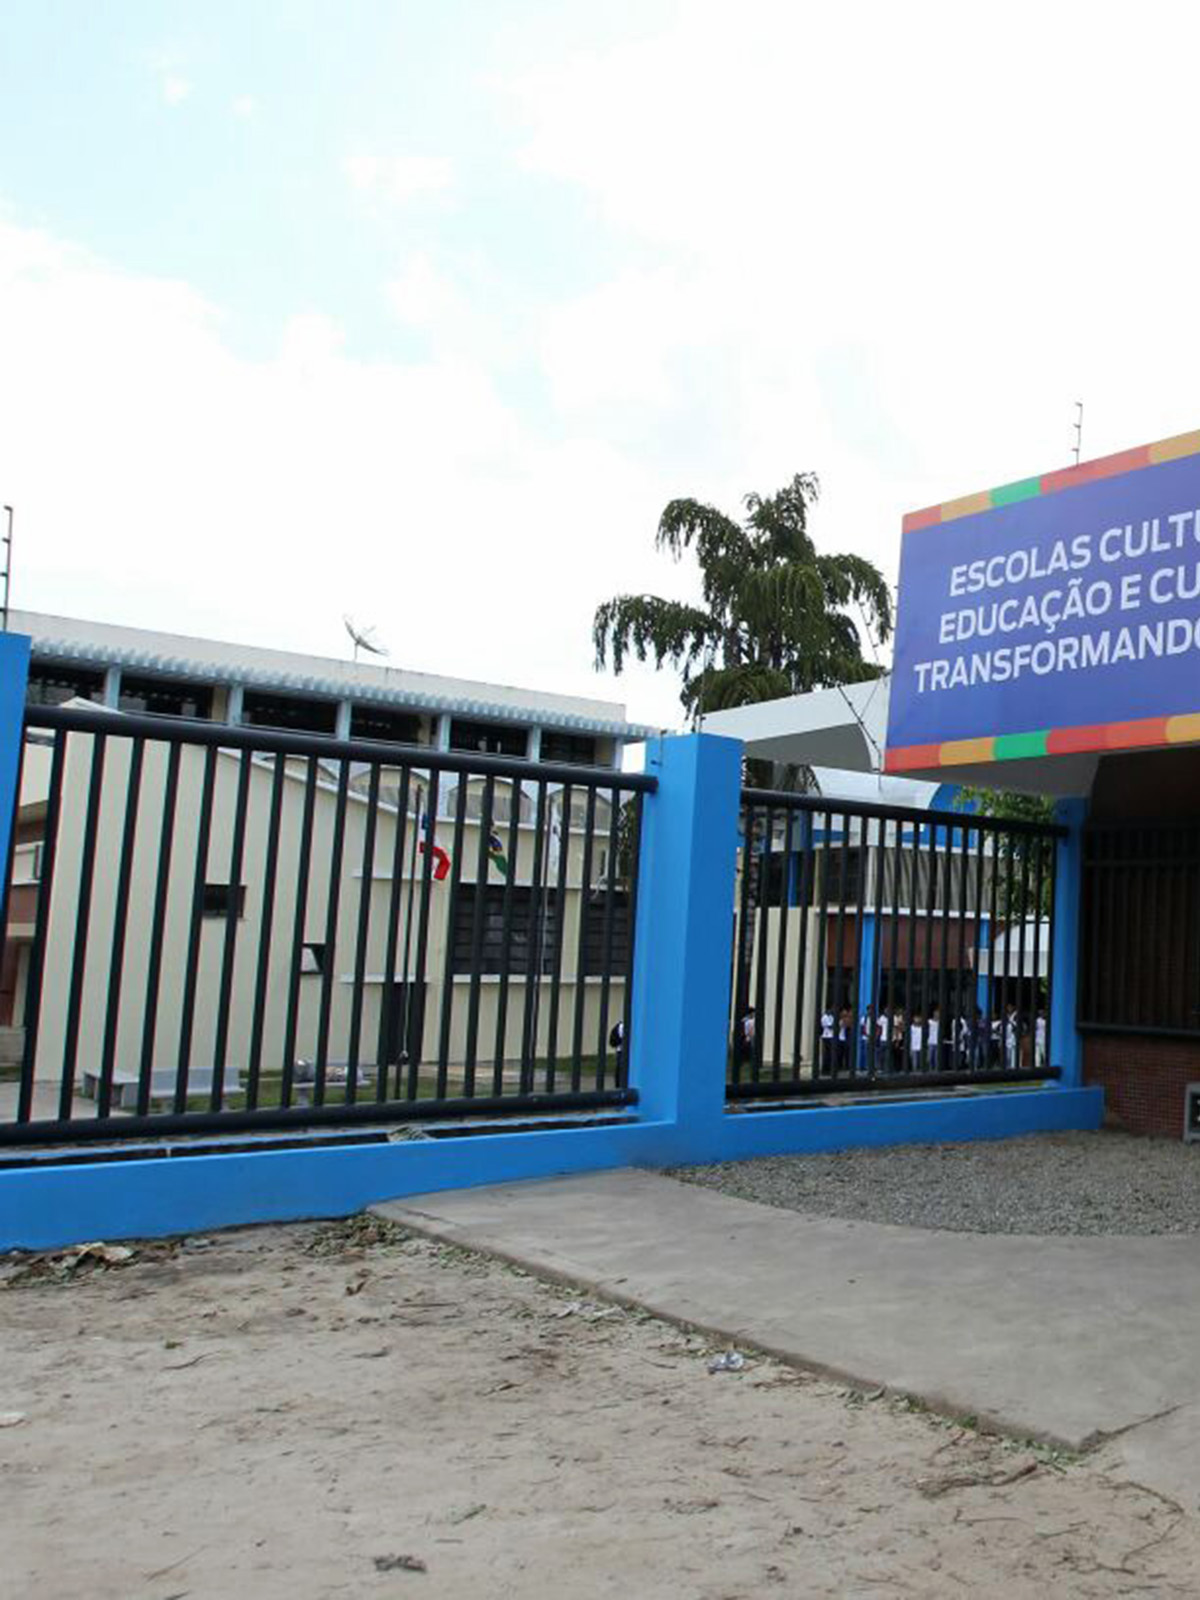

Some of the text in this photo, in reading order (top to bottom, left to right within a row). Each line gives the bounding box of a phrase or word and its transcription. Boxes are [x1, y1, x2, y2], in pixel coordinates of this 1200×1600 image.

[949, 534, 1092, 597] ESCOLAS
[938, 577, 1113, 644] EDUCAÇÃO
[1120, 573, 1142, 610] E
